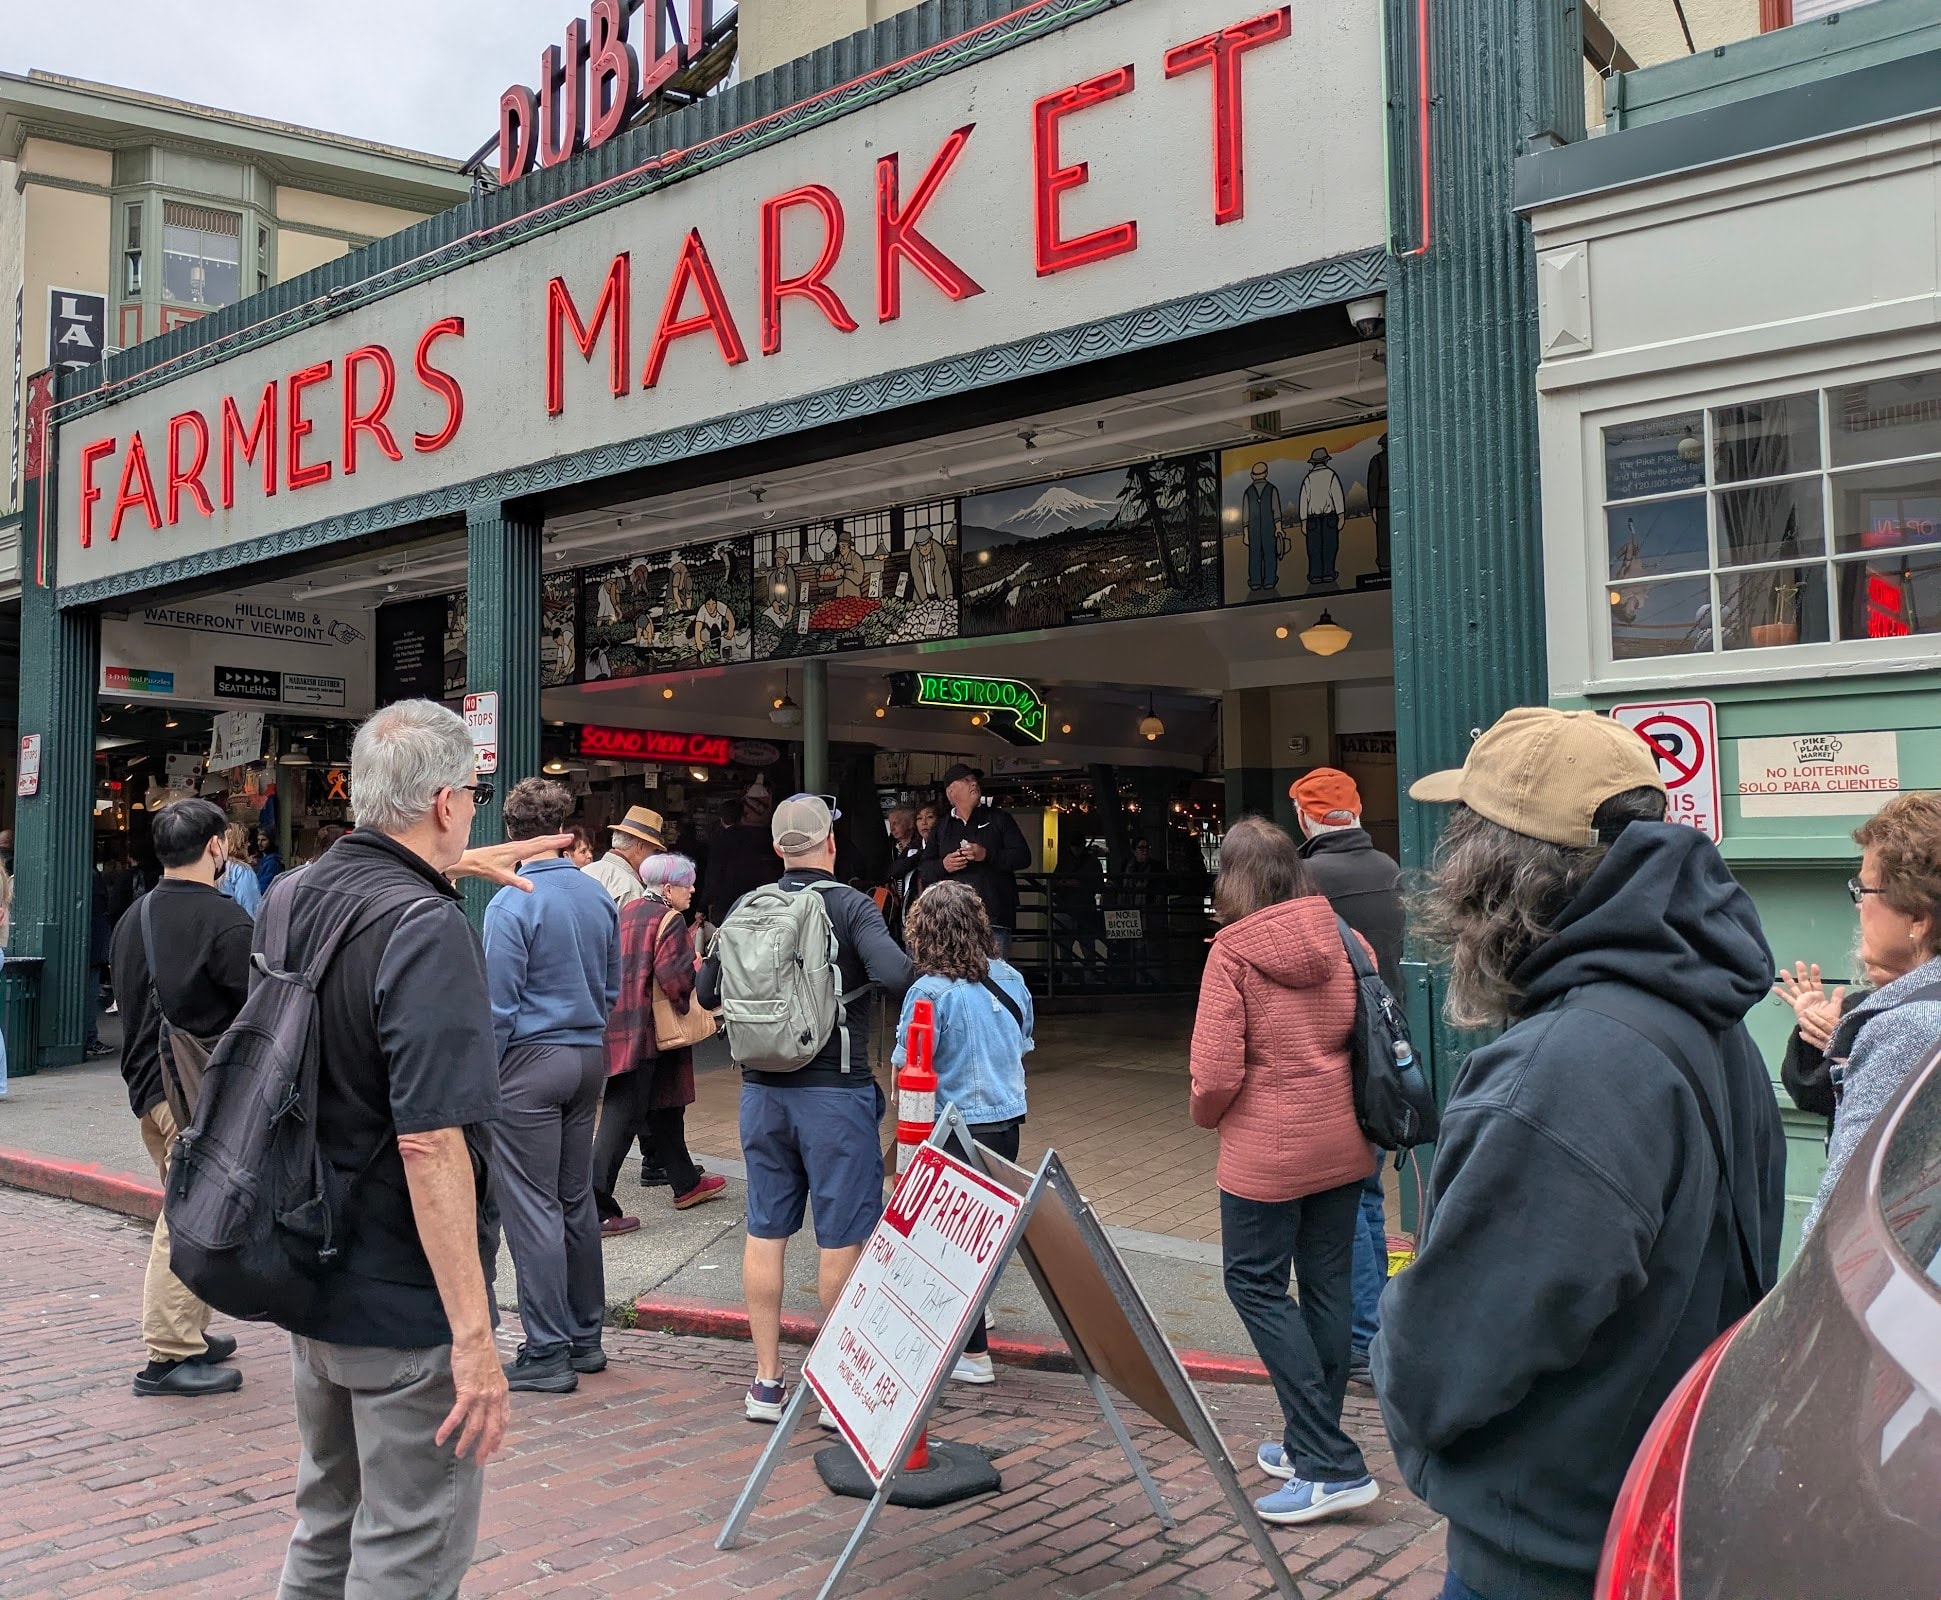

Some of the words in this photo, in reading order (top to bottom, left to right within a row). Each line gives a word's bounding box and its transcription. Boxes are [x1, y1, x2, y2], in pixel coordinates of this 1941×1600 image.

[79, 316, 465, 549] FARMERS
[545, 5, 1292, 417] MARKET
[1636, 457, 1655, 467] Pike
[1657, 454, 1682, 464] Place
[1632, 470, 1646, 479] the
[1669, 464, 1687, 474] and
[235, 602, 306, 623] HILLCLIMB
[312, 613, 322, 625] &
[144, 608, 244, 631] WATERFRONT
[250, 620, 325, 641] VIEWPOINT
[121, 674, 143, 684] Wood
[143, 677, 171, 687] Puzzles
[317, 679, 341, 688] LEATHER
[466, 698, 476, 710] NO
[925, 678, 1042, 728] RESTROOMS
[468, 712, 493, 727] STOPS
[647, 731, 686, 754] VIEW
[1800, 744, 1830, 753] PLACE
[1802, 737, 1826, 746] PIKE
[1800, 751, 1832, 760] MARKET
[1766, 767, 1787, 778] NO
[1793, 764, 1870, 777] LOITERING
[1739, 782, 1778, 793] SOLO
[1784, 780, 1821, 791] PARA
[1826, 778, 1899, 790] CLIENTES
[1108, 920, 1139, 929] BICYCLE
[1106, 928, 1142, 937] PARKING
[892, 1160, 935, 1221] NO
[922, 1179, 1004, 1264] PARKING
[869, 1234, 896, 1269] FROM
[850, 1282, 867, 1309] TO
[836, 1359, 855, 1387] PHONE
[837, 1326, 878, 1380] TOW-AWAY
[872, 1372, 900, 1412] AREA
